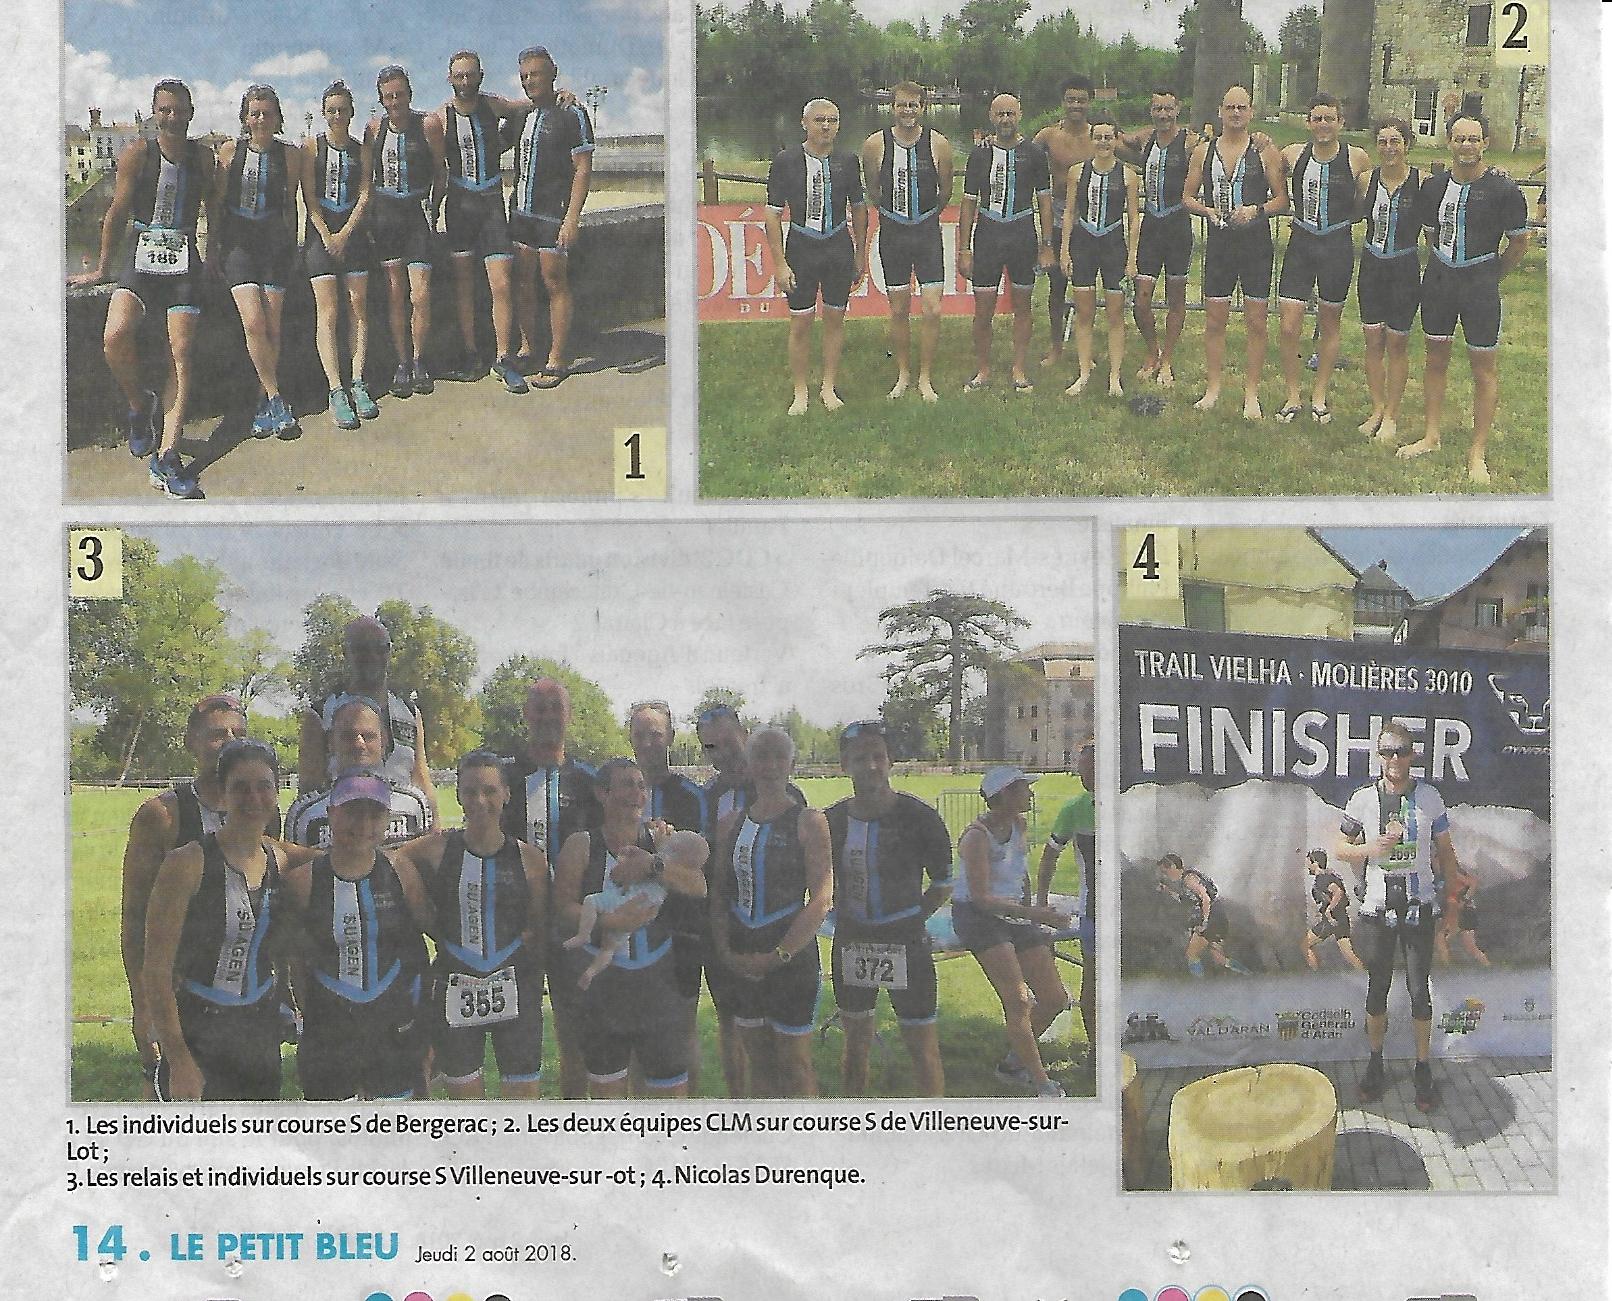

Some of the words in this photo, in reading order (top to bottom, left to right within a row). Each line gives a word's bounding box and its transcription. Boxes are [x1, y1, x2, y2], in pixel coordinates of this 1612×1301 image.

[1502, 2, 1528, 49] 2
[624, 433, 646, 479] 1
[77, 536, 104, 582] 3
[1132, 533, 1160, 580] 4
[1134, 650, 1204, 681] TRAIL
[1210, 655, 1293, 686] VIELHA
[1311, 660, 1420, 693] MOLIÈRES
[1425, 669, 1473, 696] 3010
[1138, 702, 1473, 784] FINISHER
[1389, 848, 1417, 861] 2099
[855, 956, 894, 982] 372
[460, 985, 506, 1019] 355
[66, 1120, 79, 1134] 1.
[87, 1115, 118, 1135] Les
[123, 1114, 236, 1134] individuels
[241, 1119, 274, 1134] sur
[278, 1119, 346, 1134] course
[350, 1115, 361, 1134] S
[365, 1114, 392, 1134] de
[504, 1117, 520, 1133] 2.
[528, 1114, 560, 1133] Les
[564, 1113, 616, 1133] deux
[619, 1112, 701, 1138] équipes
[706, 1113, 753, 1132] CLM
[756, 1117, 789, 1132] sur
[793, 1117, 861, 1132] course
[865, 1113, 877, 1131] S
[880, 1111, 907, 1131] de
[909, 1110, 1069, 1131] Villeneuve-sur-
[68, 1142, 100, 1161] Lot
[123, 1167, 179, 1187] relais
[183, 1168, 204, 1187] et
[208, 1165, 323, 1187] individuels
[327, 1171, 360, 1186] sur
[363, 1171, 432, 1186] course
[436, 1166, 447, 1186] S
[449, 1164, 603, 1186] Villeneuve-sur
[756, 1164, 866, 1190] Durenque.
[73, 1225, 128, 1262] 14
[170, 1233, 204, 1261] LE
[217, 1232, 304, 1261] PETIT
[316, 1231, 399, 1261] BLEU
[414, 1244, 458, 1263] Jeudi
[465, 1246, 476, 1262] 2
[482, 1243, 520, 1262] août
[525, 1244, 577, 1262] 2018.
